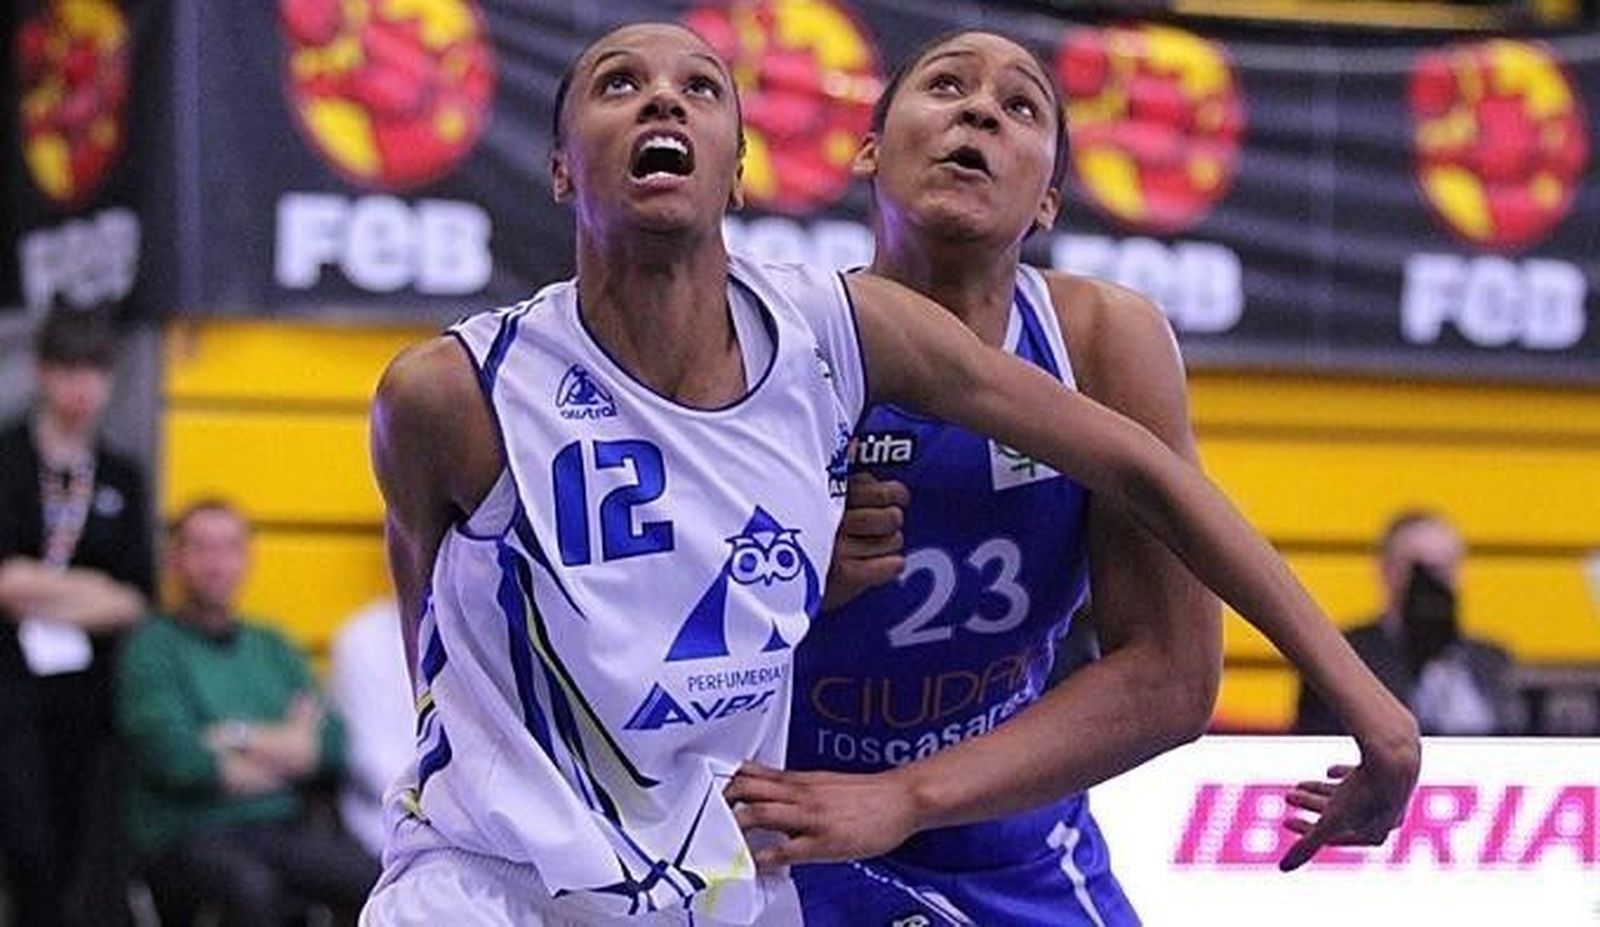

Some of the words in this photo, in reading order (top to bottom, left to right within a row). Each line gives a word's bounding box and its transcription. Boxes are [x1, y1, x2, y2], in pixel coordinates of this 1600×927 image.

[552, 439, 675, 567] 12
[886, 538, 1031, 648] 23
[811, 655, 1032, 727] CIUDA
